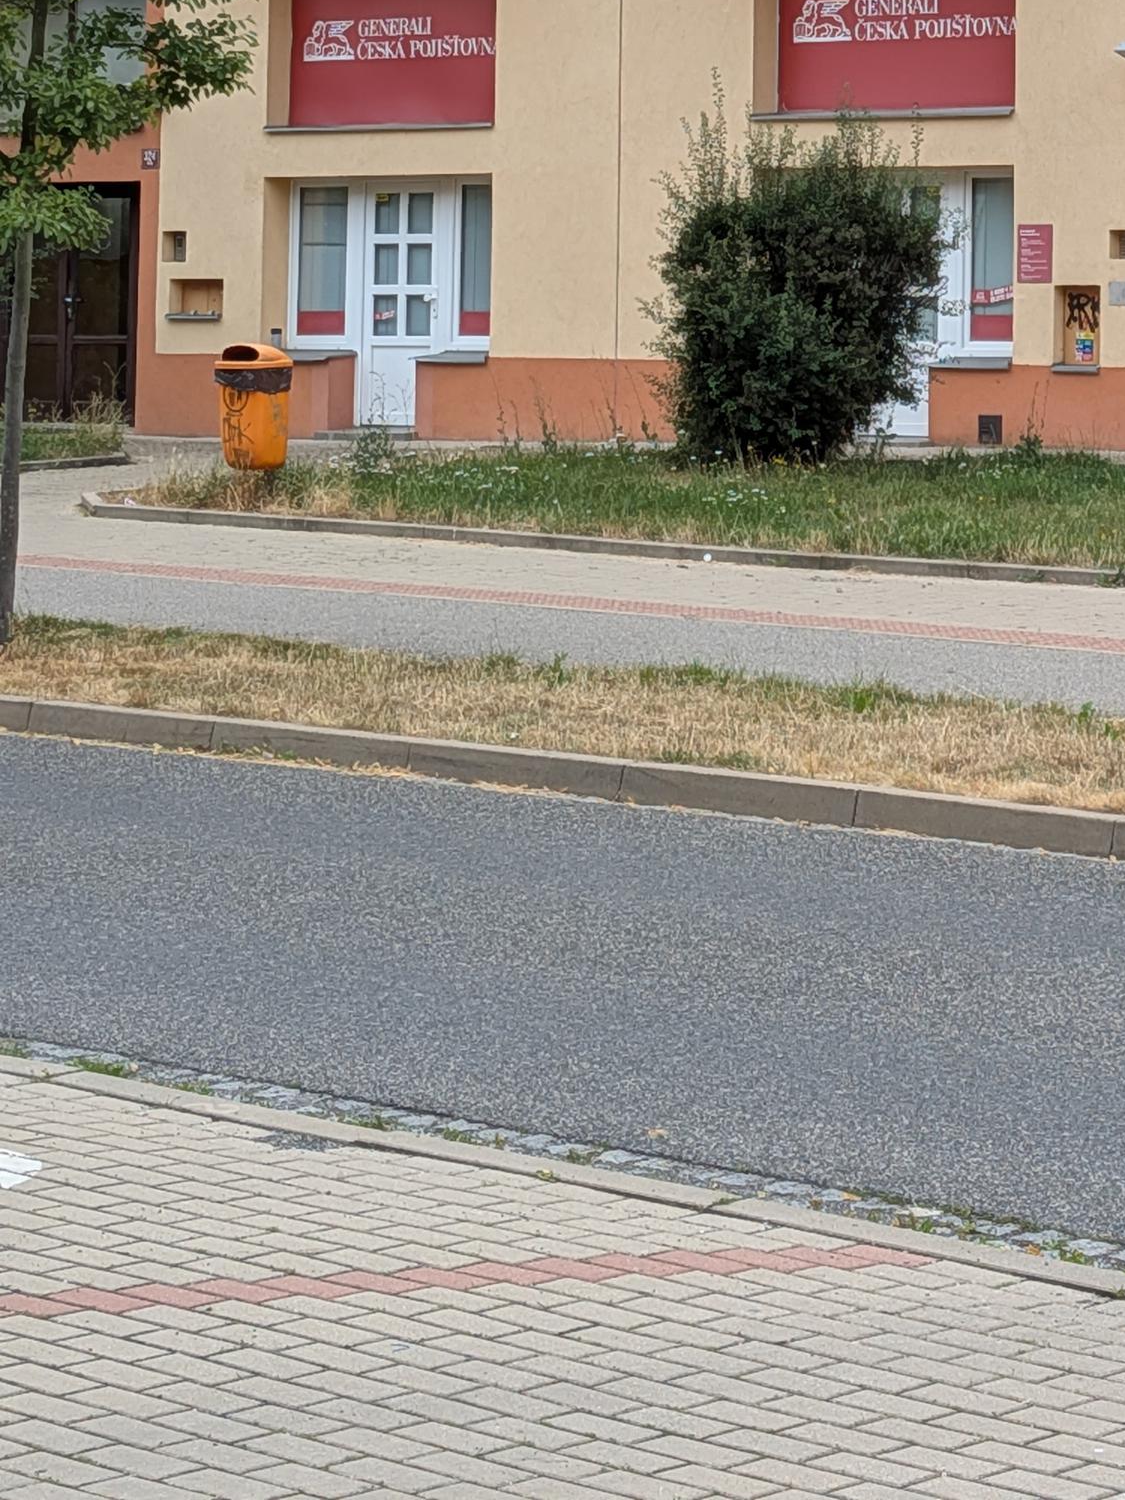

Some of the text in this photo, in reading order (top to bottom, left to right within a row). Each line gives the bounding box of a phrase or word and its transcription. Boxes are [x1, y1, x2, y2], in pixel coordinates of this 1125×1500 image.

[358, 17, 432, 37] GENERALI
[855, 18, 909, 41] ČESKÁ
[357, 35, 496, 60] ČESKÁ POJIŠŤOVN
